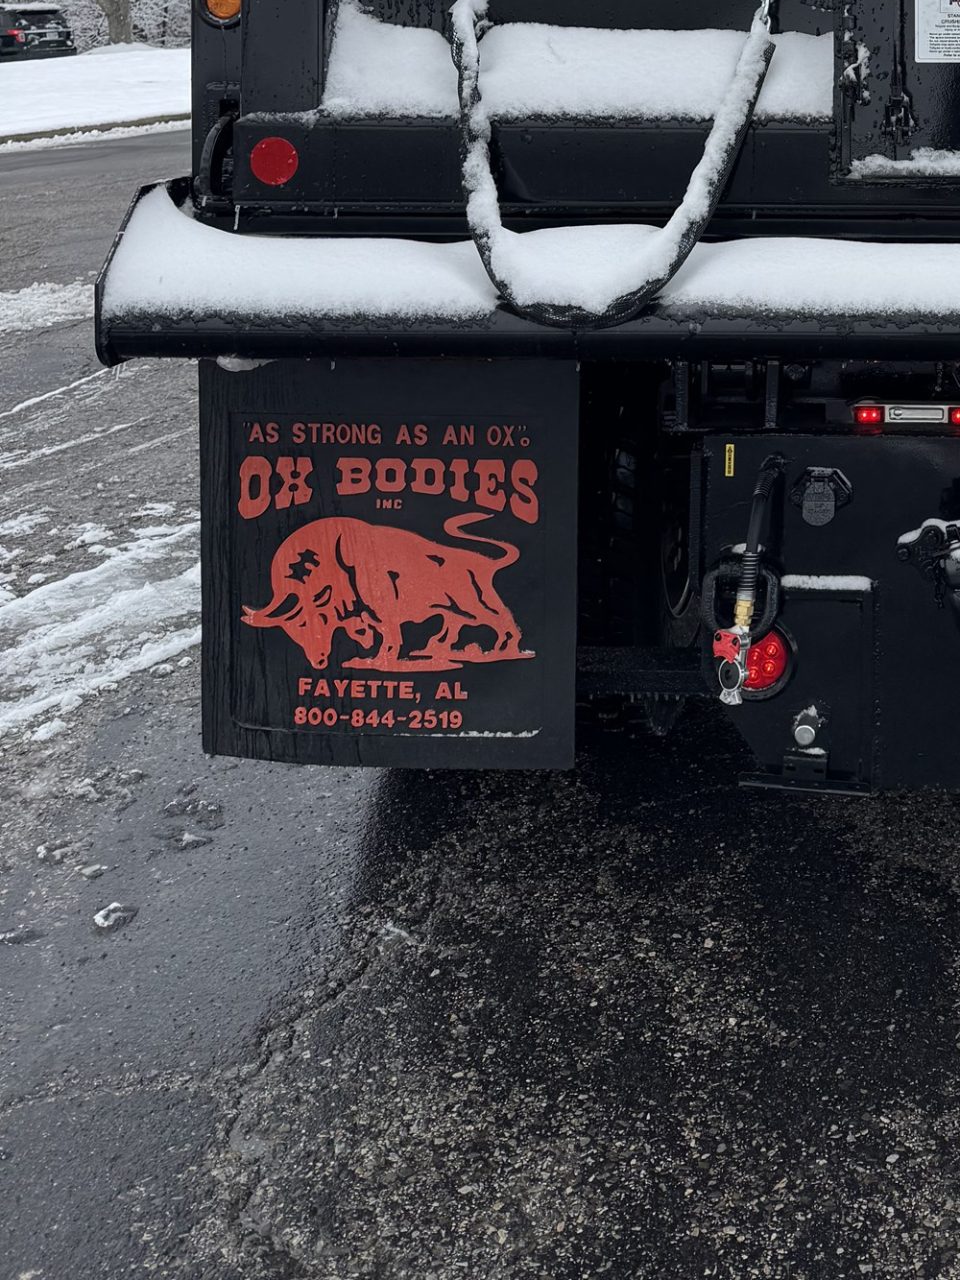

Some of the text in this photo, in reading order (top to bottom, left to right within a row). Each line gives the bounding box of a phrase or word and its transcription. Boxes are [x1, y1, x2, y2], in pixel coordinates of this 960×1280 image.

[292, 423, 381, 445] STRONG
[396, 424, 428, 446] AS
[443, 425, 475, 447] AN
[238, 455, 539, 524] OX BODIES
[376, 498, 403, 510] INC
[298, 678, 468, 704] FAYETTE, AL
[294, 707, 464, 729] 800-844-2519
